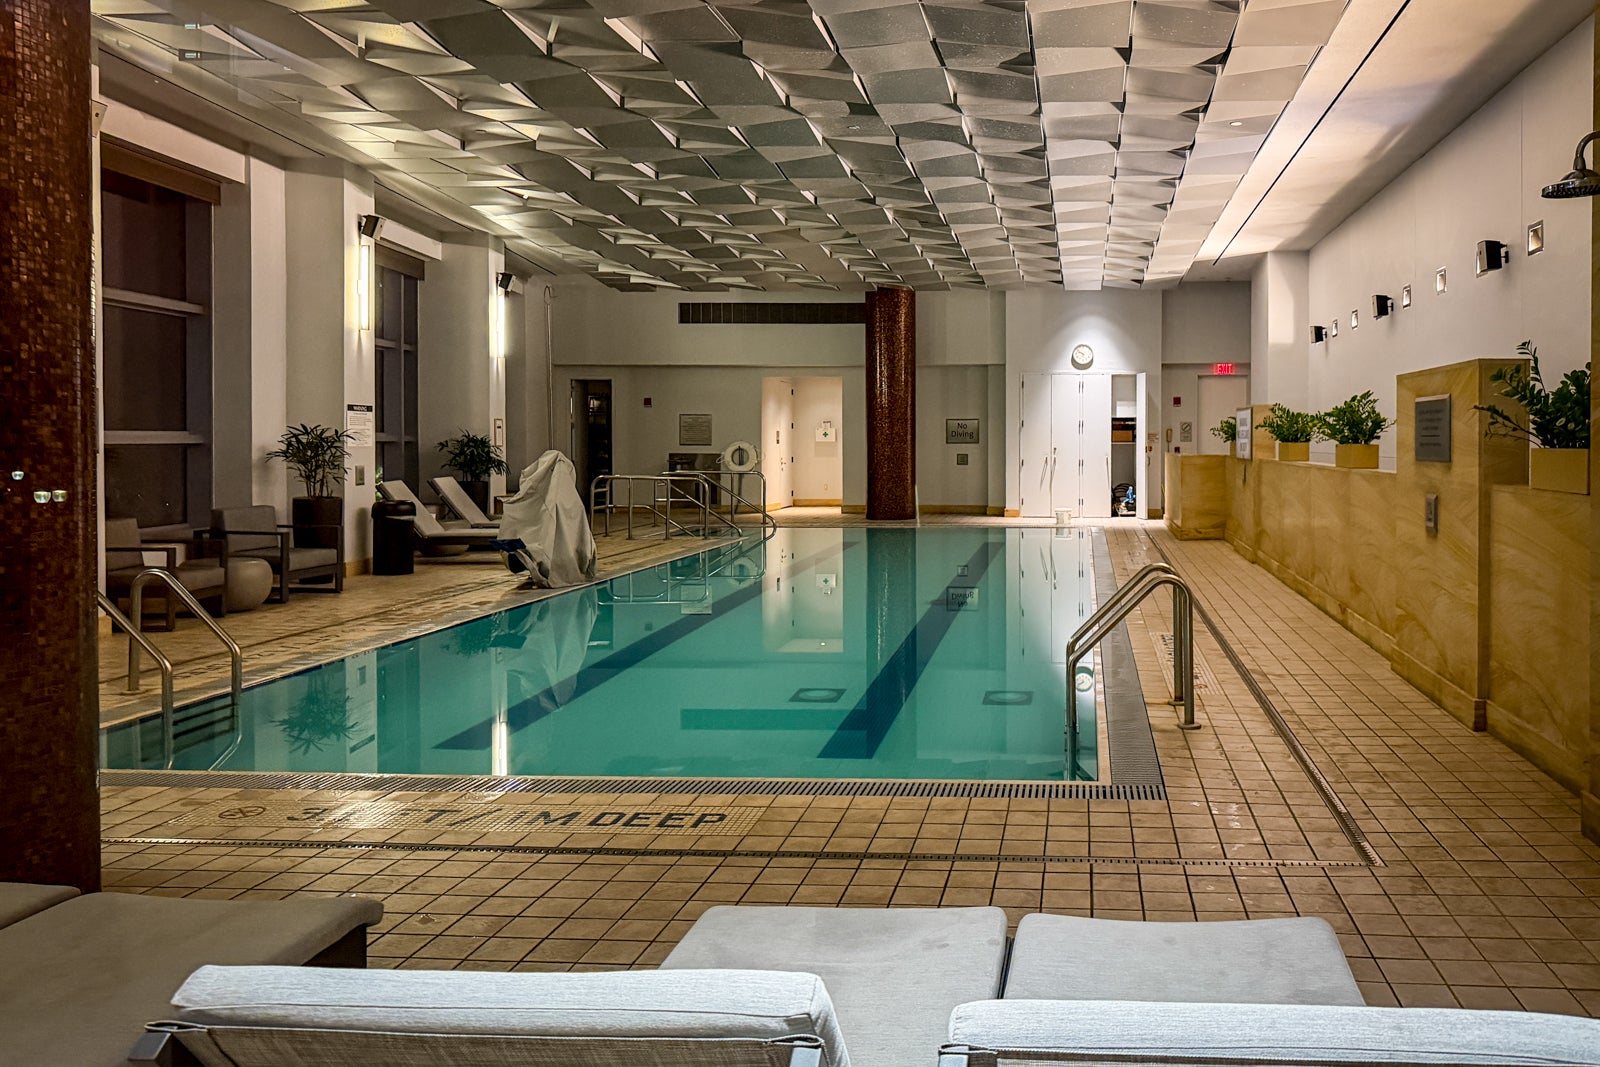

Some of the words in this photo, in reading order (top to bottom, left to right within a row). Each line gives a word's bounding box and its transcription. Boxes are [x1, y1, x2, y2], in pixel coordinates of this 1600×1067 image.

[1216, 363, 1233, 375] EXIT
[957, 422, 968, 430] No
[951, 430, 975, 440] Diving
[587, 811, 728, 828] DEEP
